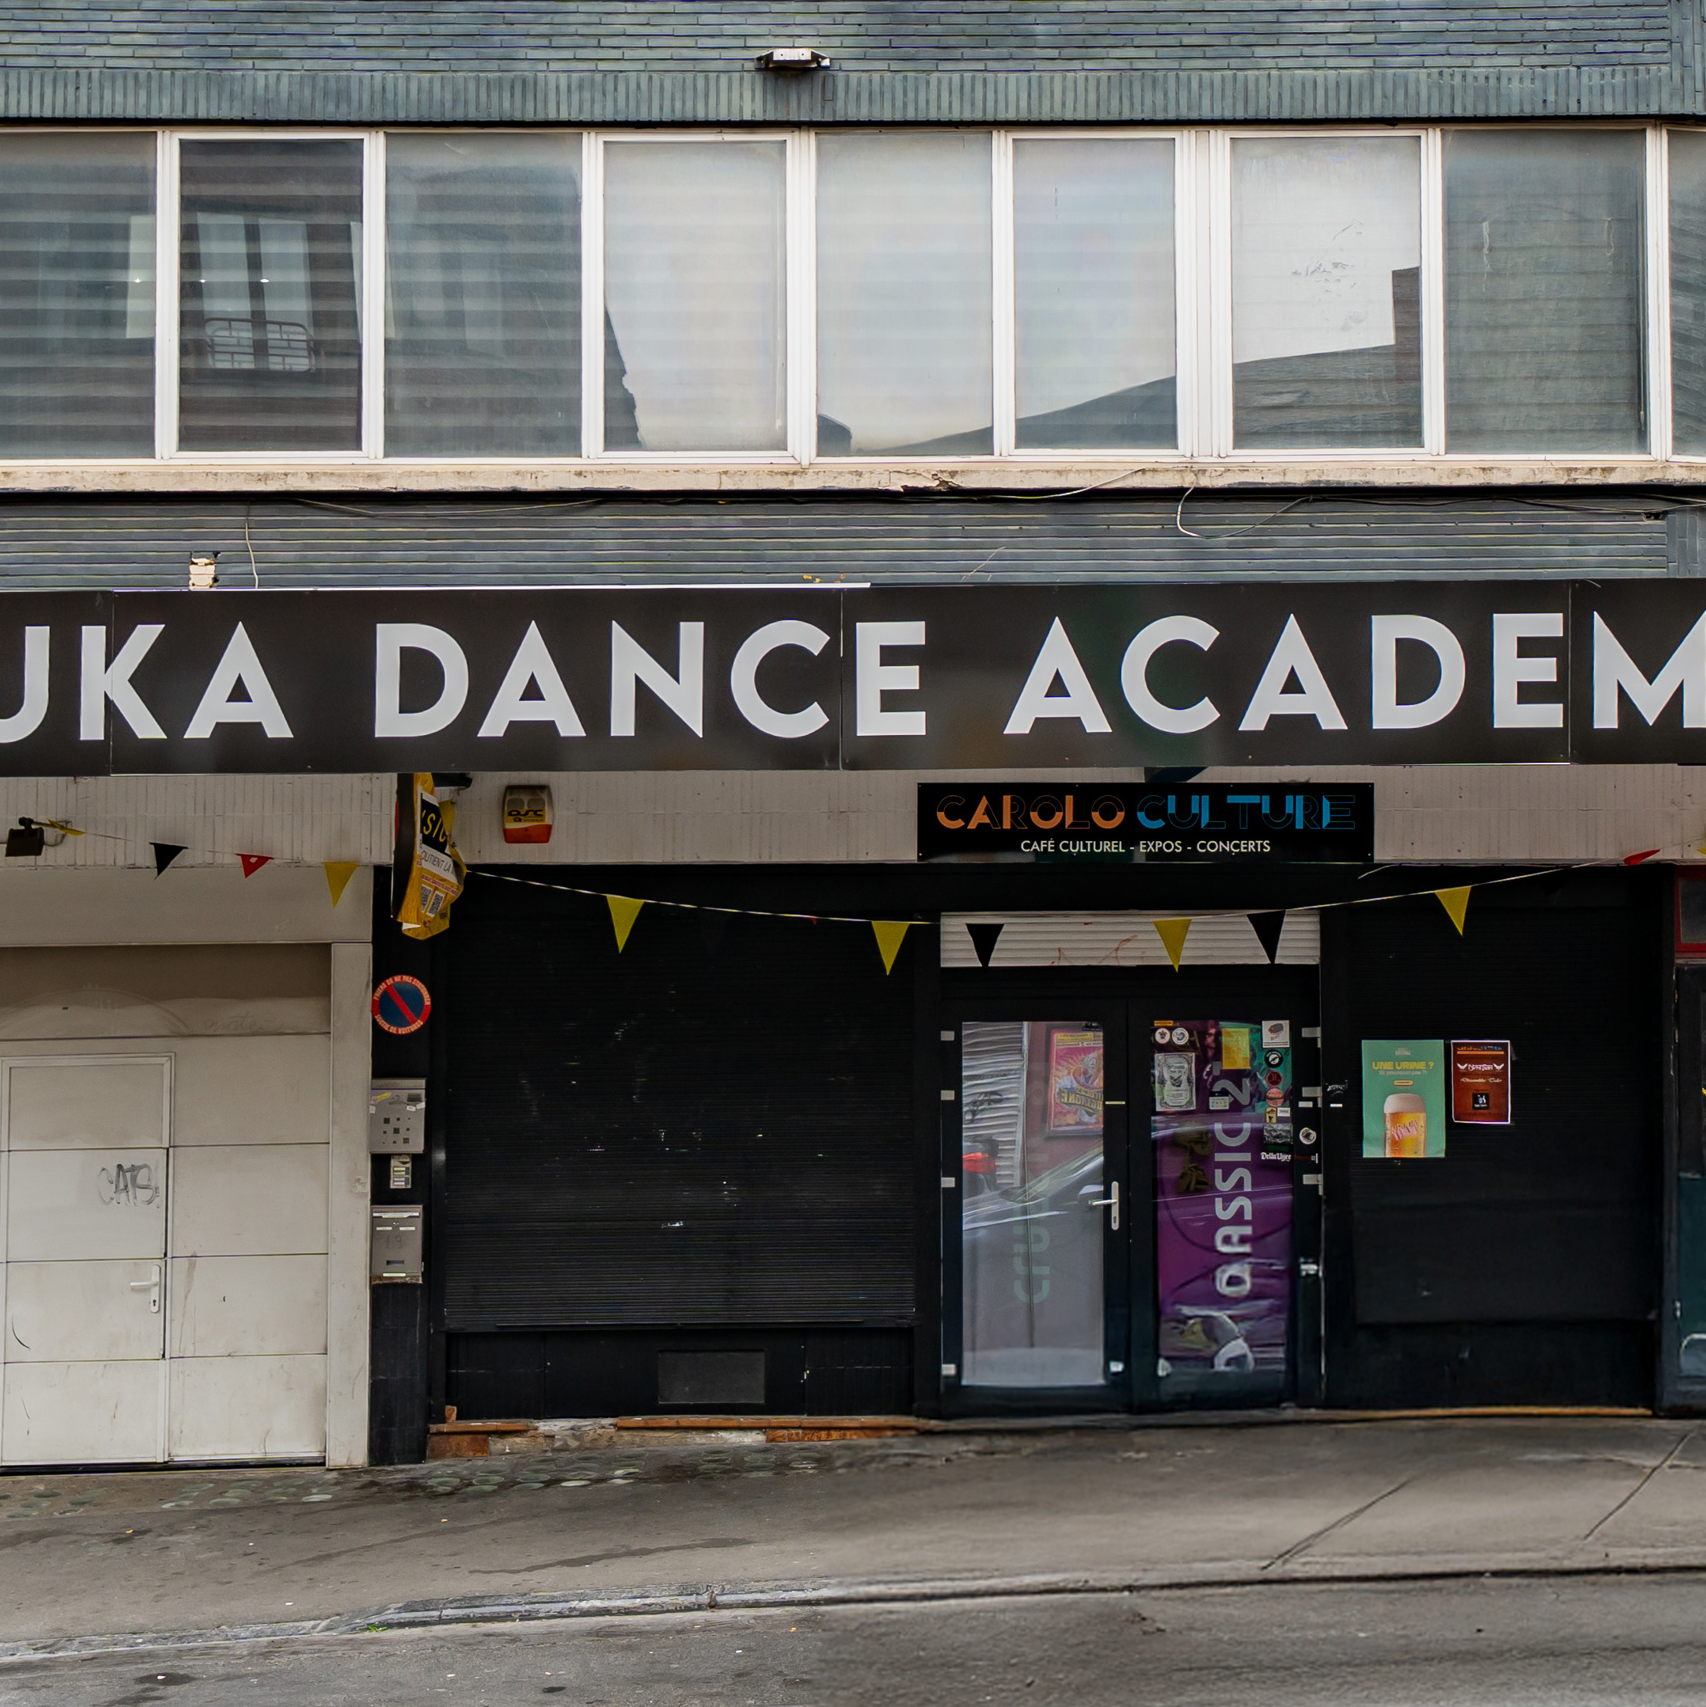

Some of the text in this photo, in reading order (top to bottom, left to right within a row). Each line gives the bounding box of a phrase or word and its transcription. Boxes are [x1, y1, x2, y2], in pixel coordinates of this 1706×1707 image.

[375, 620, 926, 738] DANCE
[936, 794, 1356, 830] CAROLO CULTURE
[1020, 837, 1056, 853] CAFÉ
[1059, 840, 1126, 853] CULTUREL
[1139, 840, 1182, 853] EXPOS
[1196, 840, 1271, 854] CONCERTS
[1372, 1061, 1394, 1070] UNE
